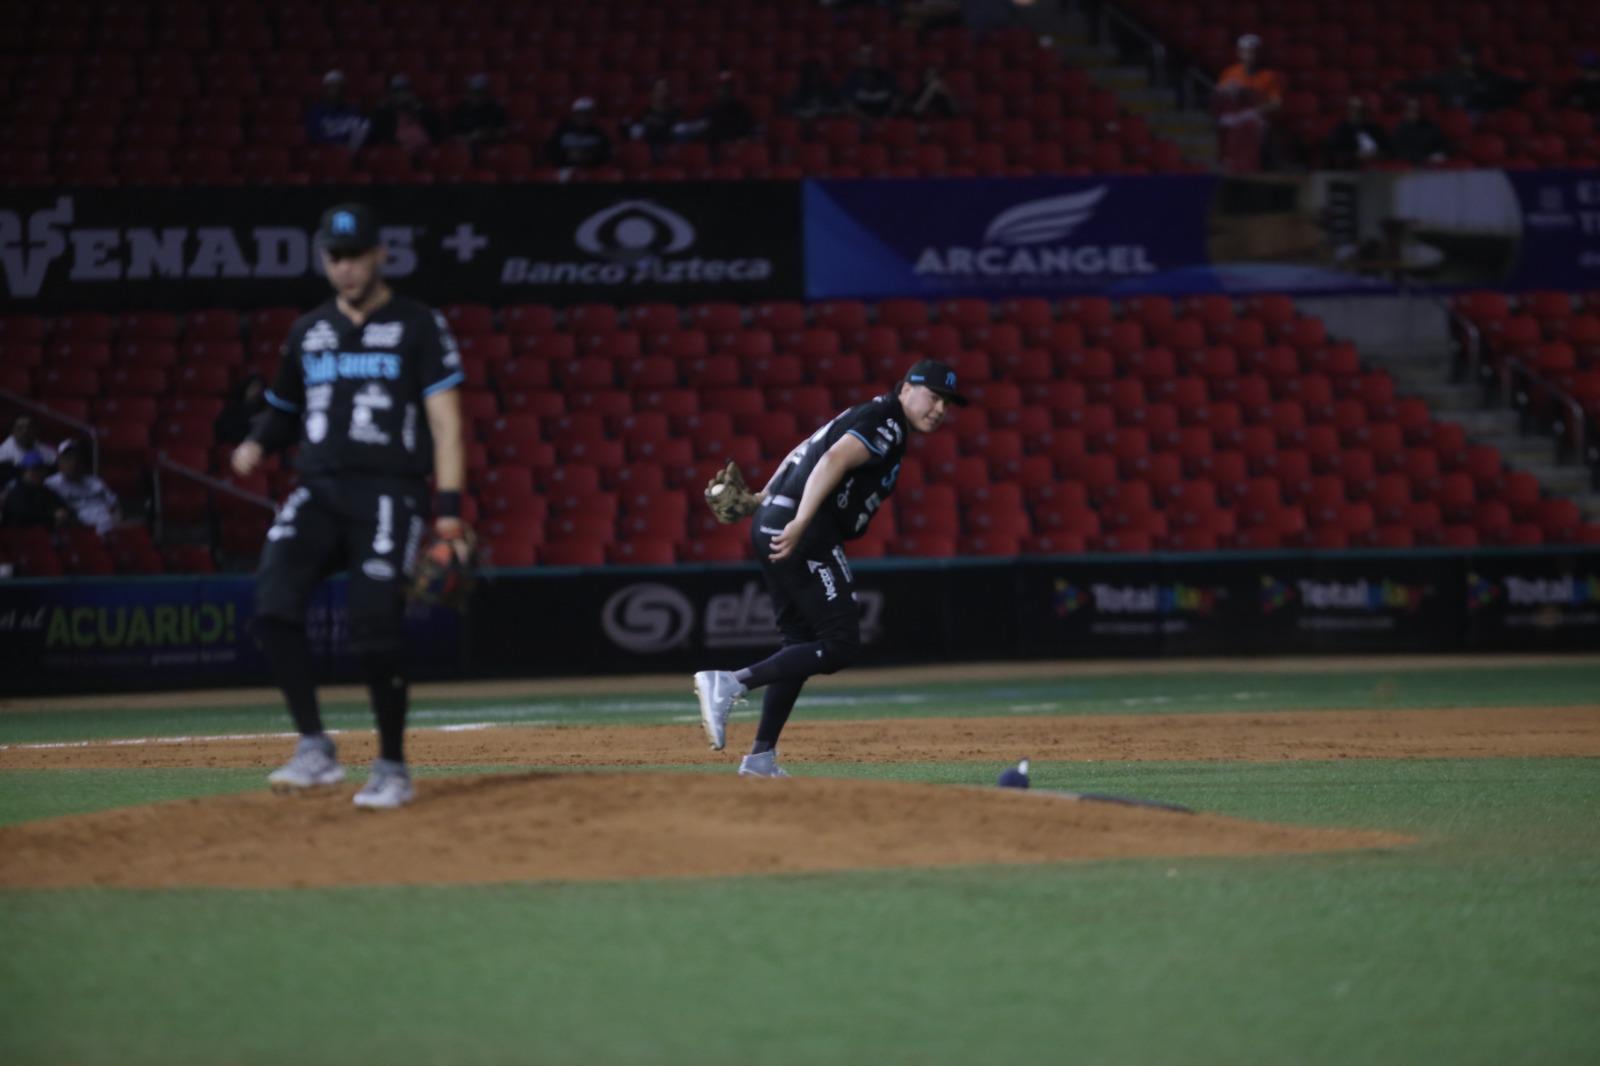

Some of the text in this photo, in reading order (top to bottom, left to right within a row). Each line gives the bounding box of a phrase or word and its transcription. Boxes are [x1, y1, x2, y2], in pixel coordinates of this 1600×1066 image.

[0, 196, 417, 298] VENADS
[914, 245, 1157, 274] ARCANGEL
[501, 255, 771, 284] Banco Azteca
[48, 602, 237, 647] ACUARIO!
